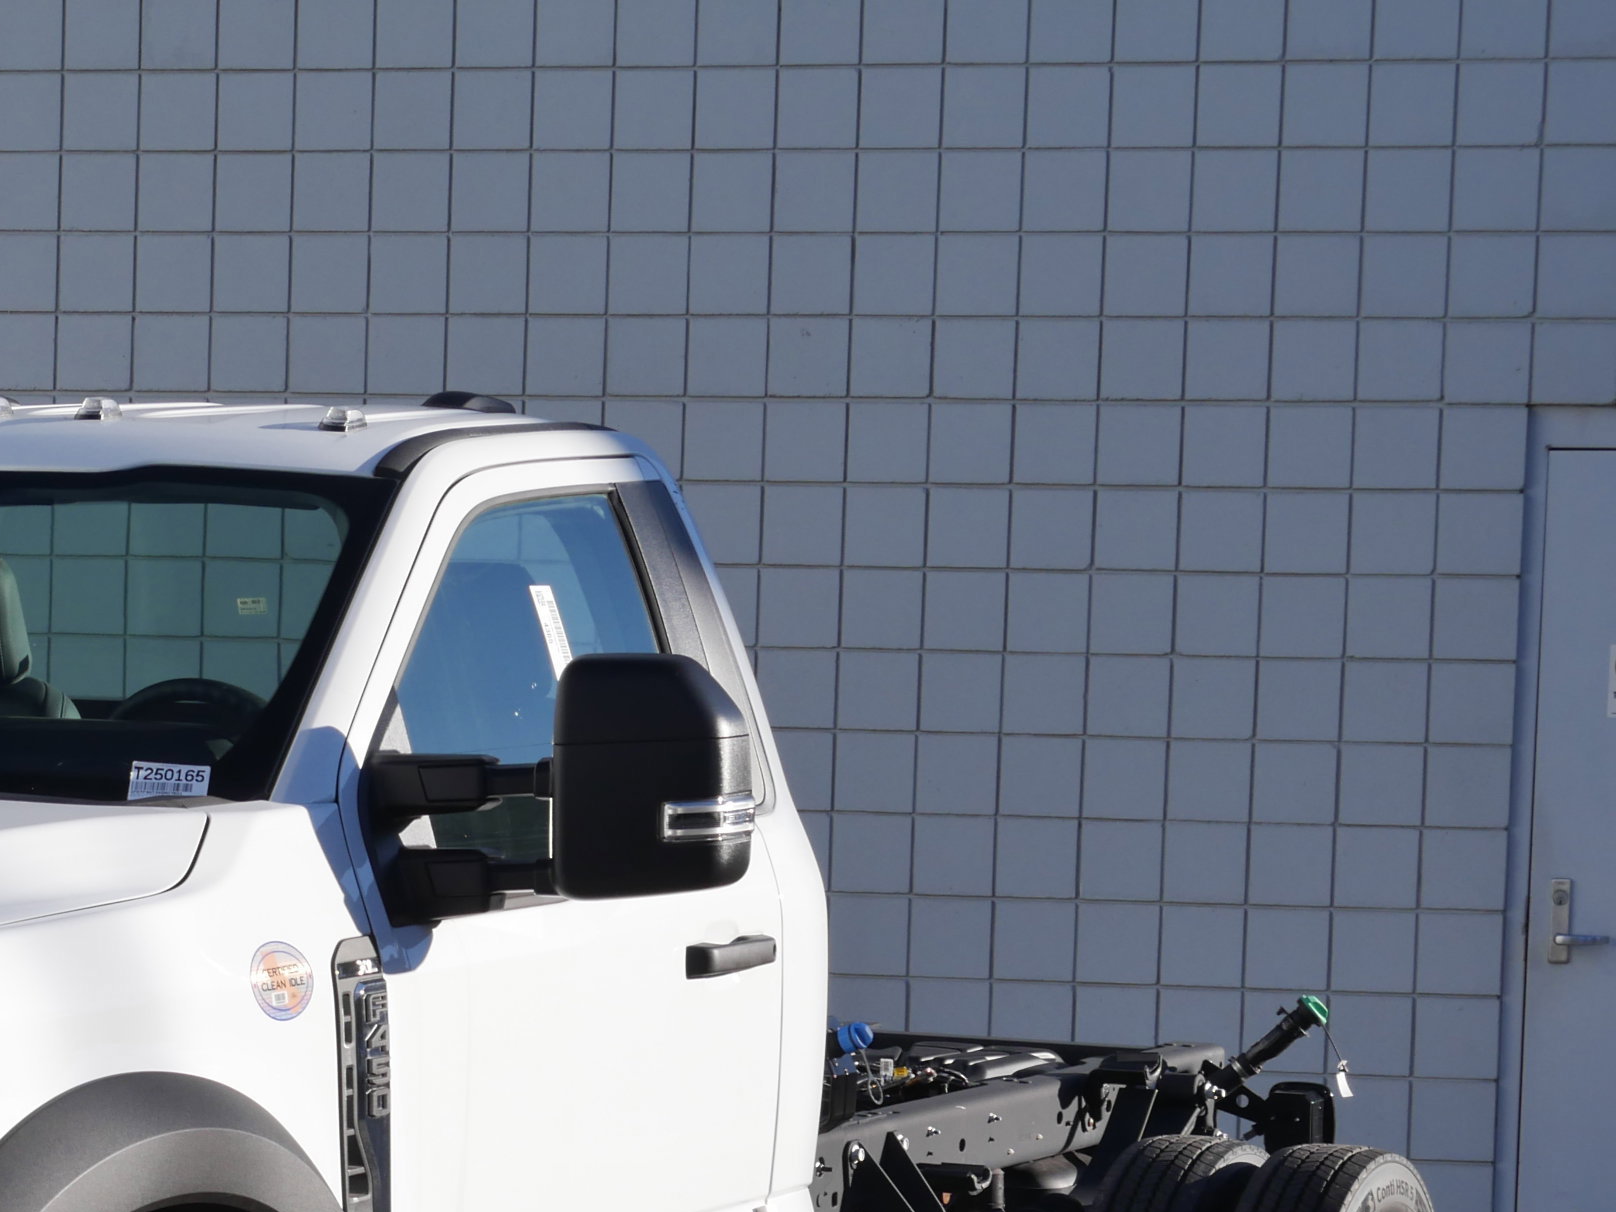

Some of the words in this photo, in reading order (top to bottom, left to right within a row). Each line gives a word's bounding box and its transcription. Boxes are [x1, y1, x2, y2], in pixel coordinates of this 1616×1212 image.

[134, 766, 206, 783] T250165
[356, 959, 379, 976] XL
[261, 979, 287, 992] CLEAN
[289, 976, 306, 987] IDLE
[1376, 1179, 1395, 1203] Conti
